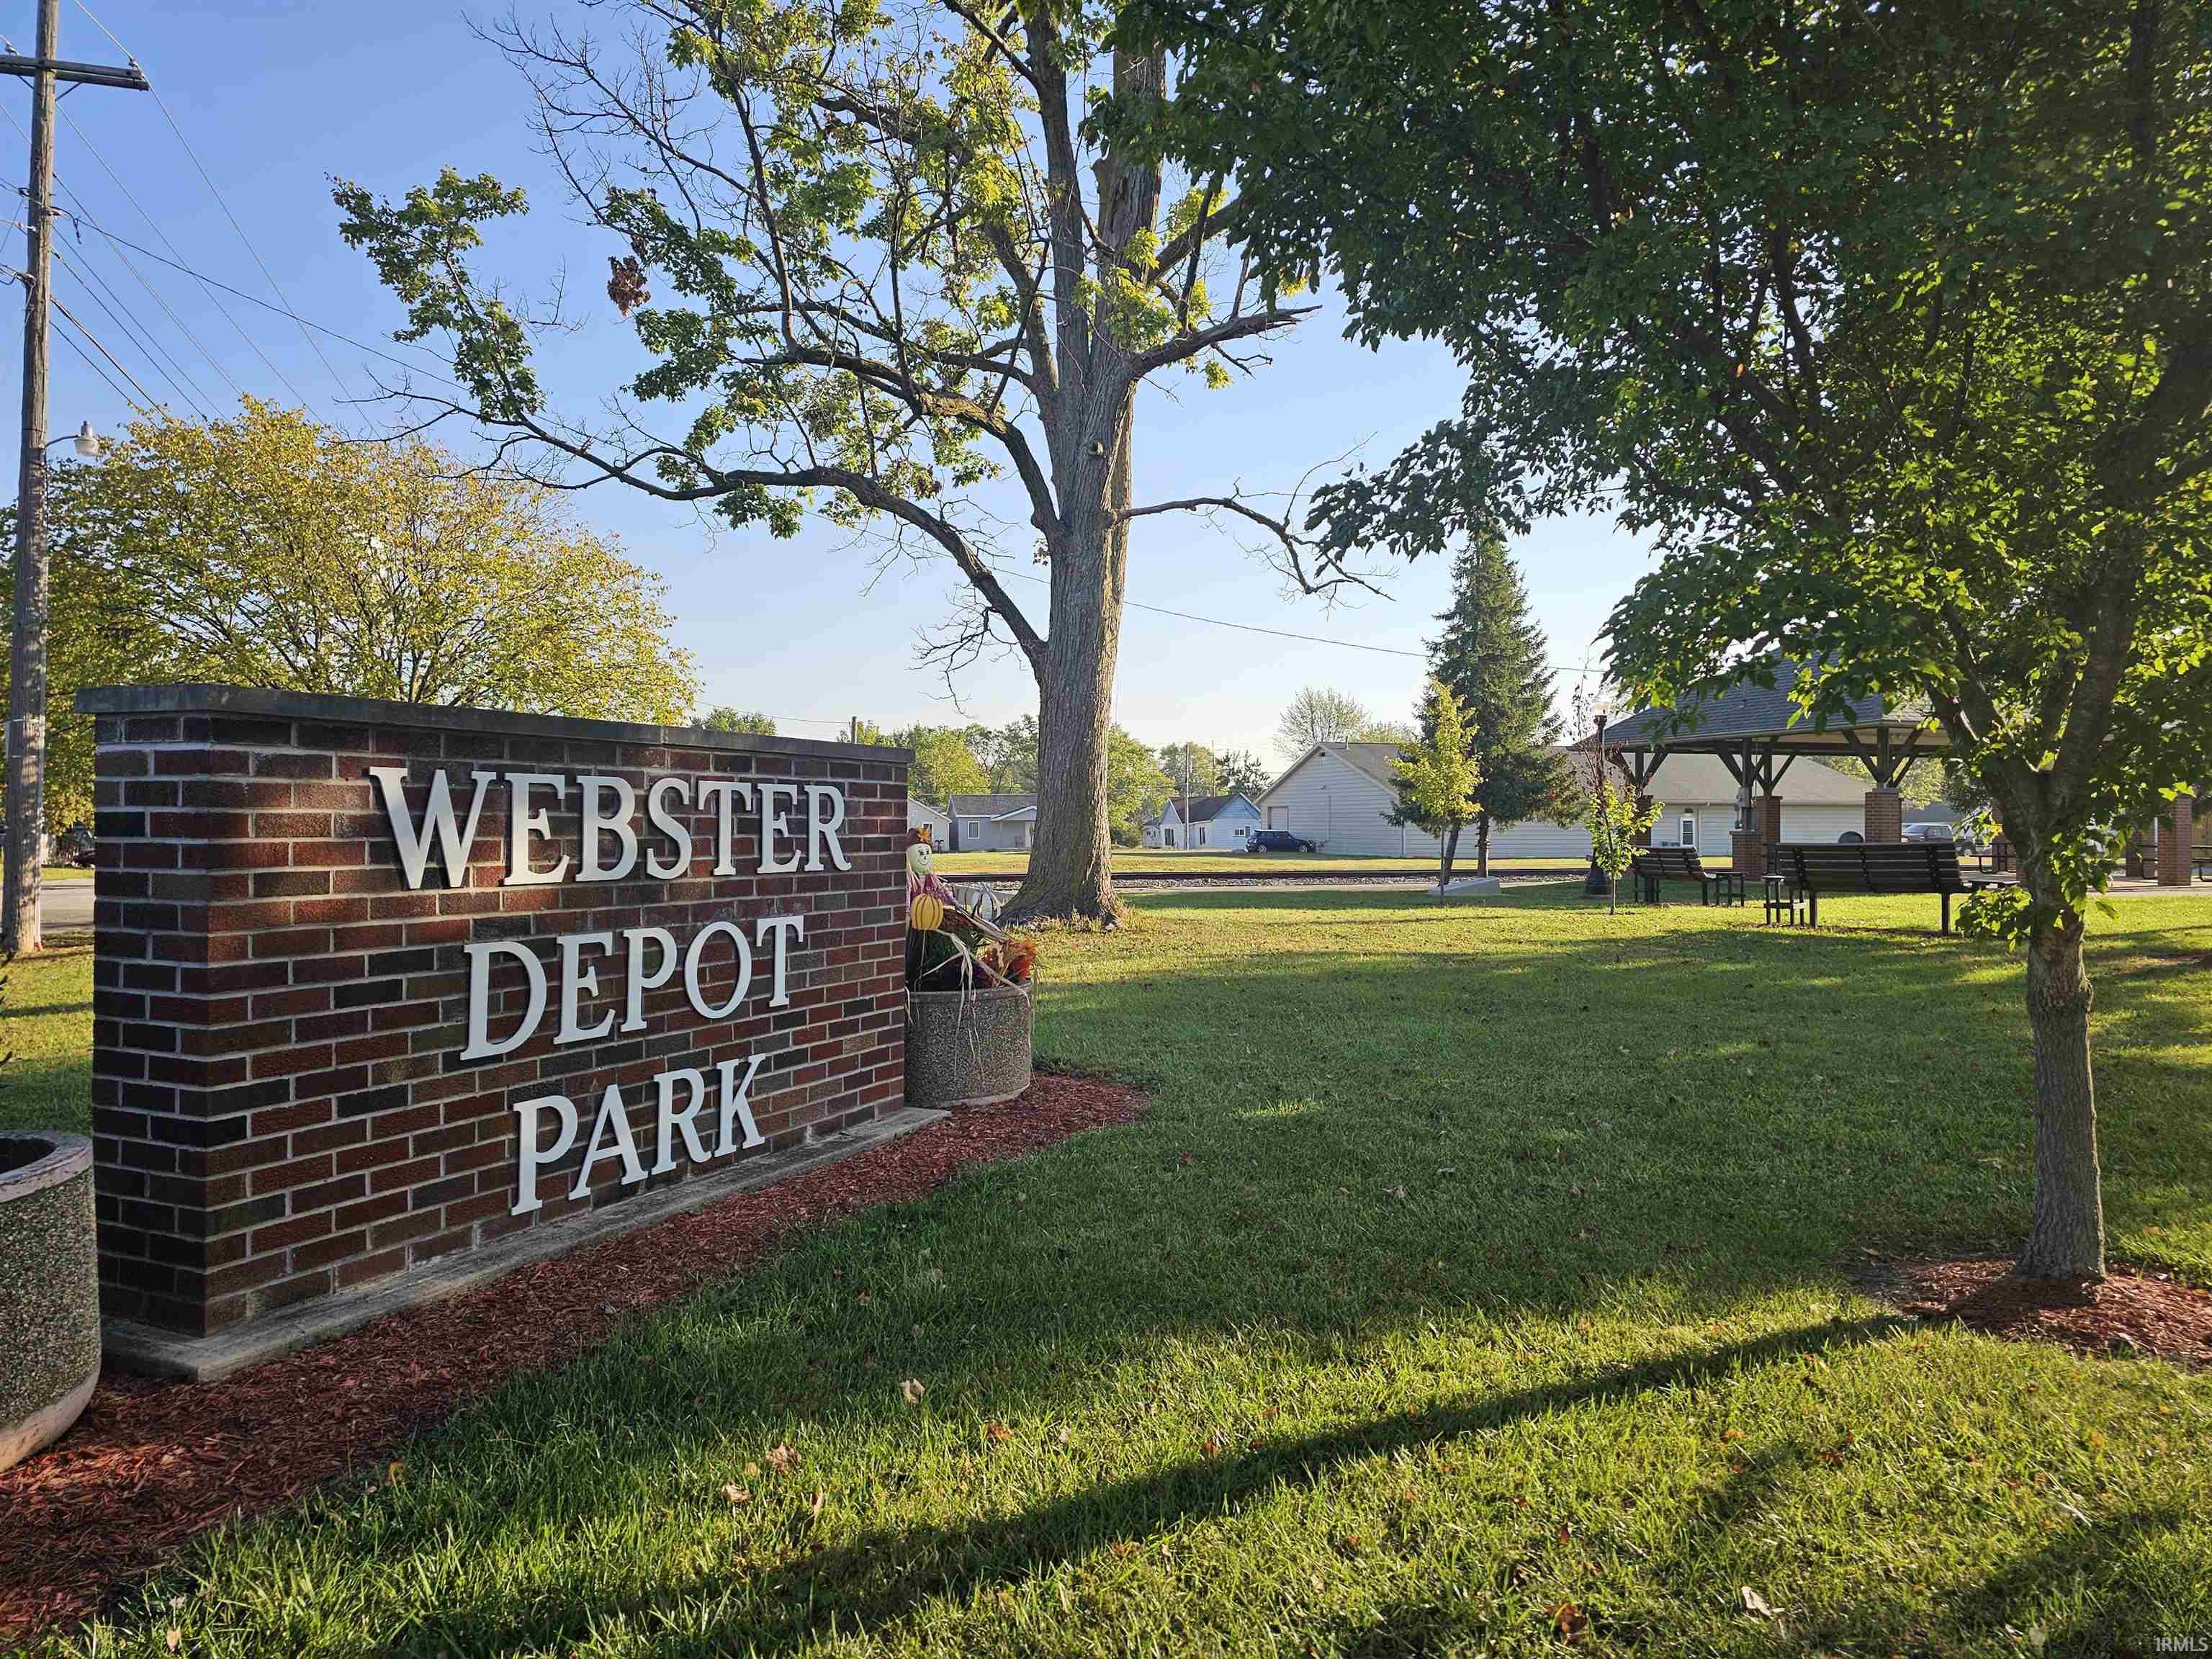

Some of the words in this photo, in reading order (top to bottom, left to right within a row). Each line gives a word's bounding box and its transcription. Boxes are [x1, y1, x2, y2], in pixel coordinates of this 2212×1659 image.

[369, 766, 851, 889] WEBSTER
[460, 915, 804, 1061] DEPOT
[512, 1053, 767, 1215] PARK
